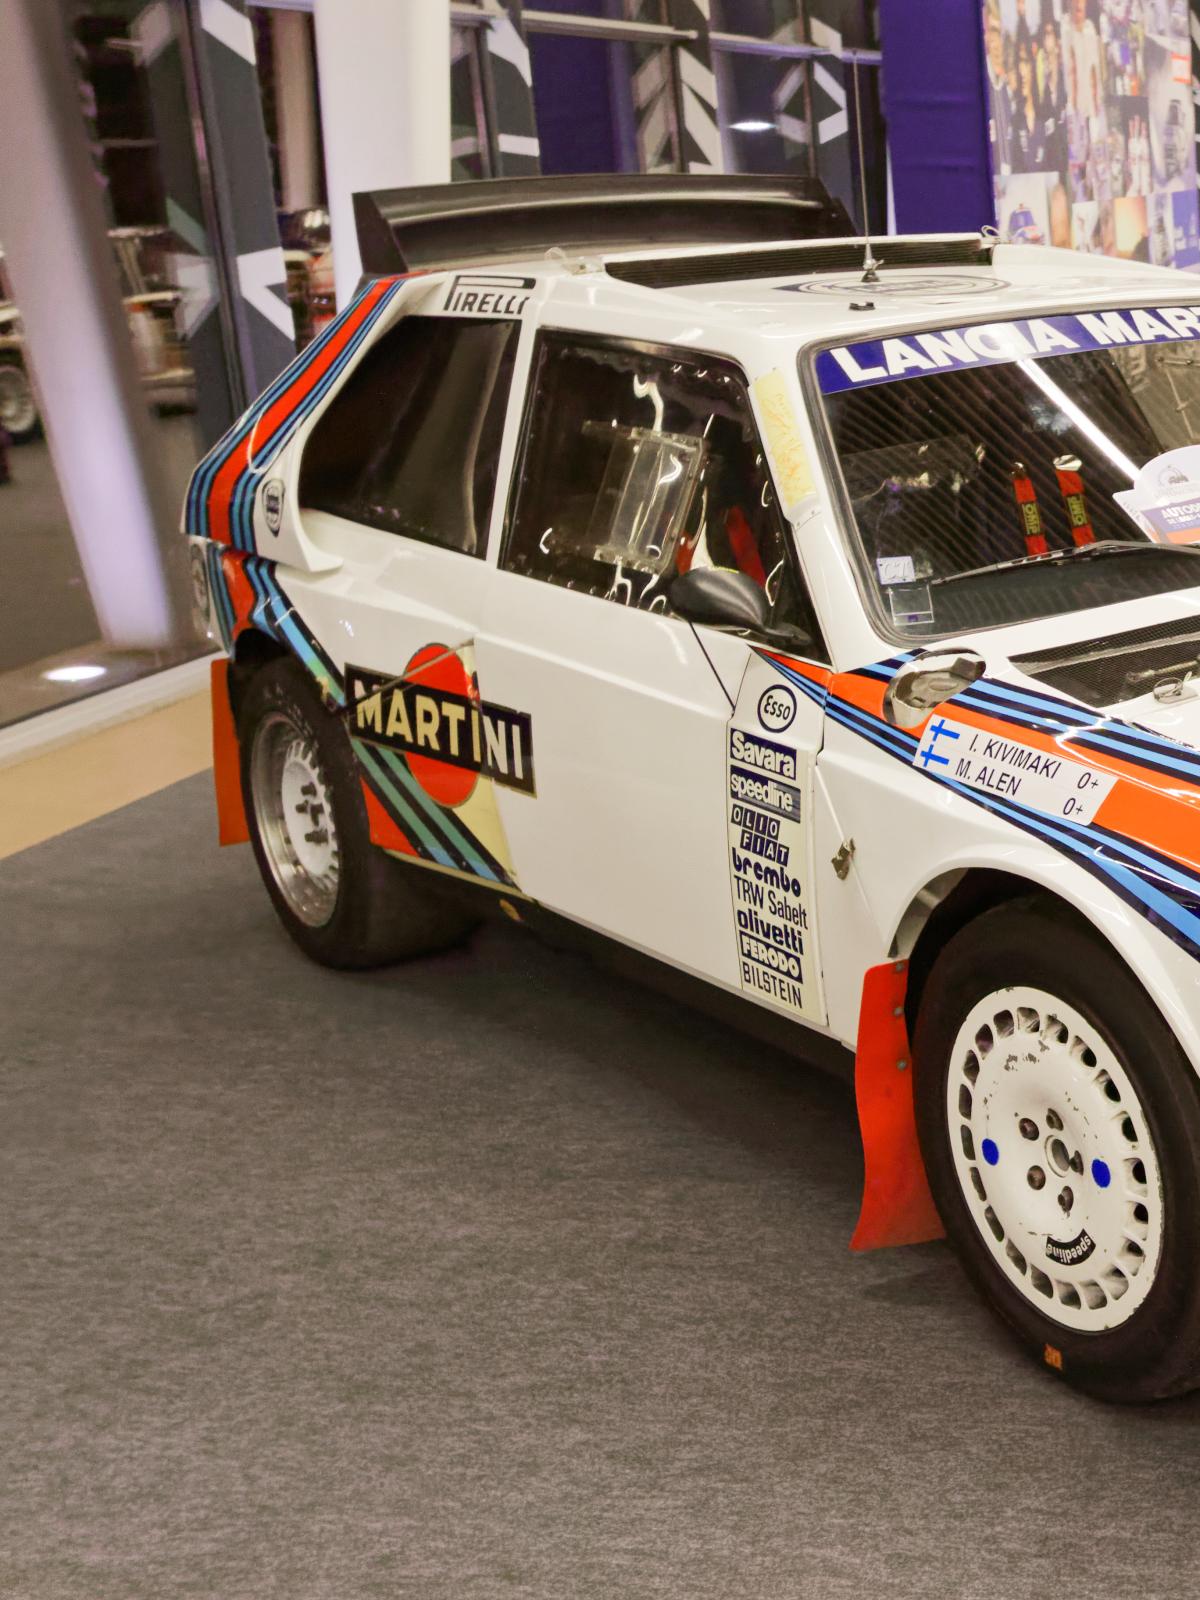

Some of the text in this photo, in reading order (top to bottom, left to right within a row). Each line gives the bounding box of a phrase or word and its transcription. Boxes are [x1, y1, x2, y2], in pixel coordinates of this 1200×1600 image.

[444, 275, 536, 315] PIRELLI
[829, 315, 1080, 383] LANCIA
[354, 680, 524, 780] MARTINI
[732, 731, 796, 779] Savara
[955, 758, 971, 780] M.
[975, 766, 1023, 796] ALEN
[969, 734, 977, 752] I.
[983, 738, 1062, 780] KIVIMAKI
[730, 772, 793, 813] speedline
[732, 806, 779, 838] OLIO
[743, 831, 788, 865] FIAT
[732, 847, 801, 898] brembo
[734, 875, 808, 931] TRW Sabelt
[737, 910, 804, 956] olivetti
[742, 934, 800, 979] FERODO
[743, 961, 802, 1009] BILSTEIN
[1047, 1235, 1092, 1264] speedline
